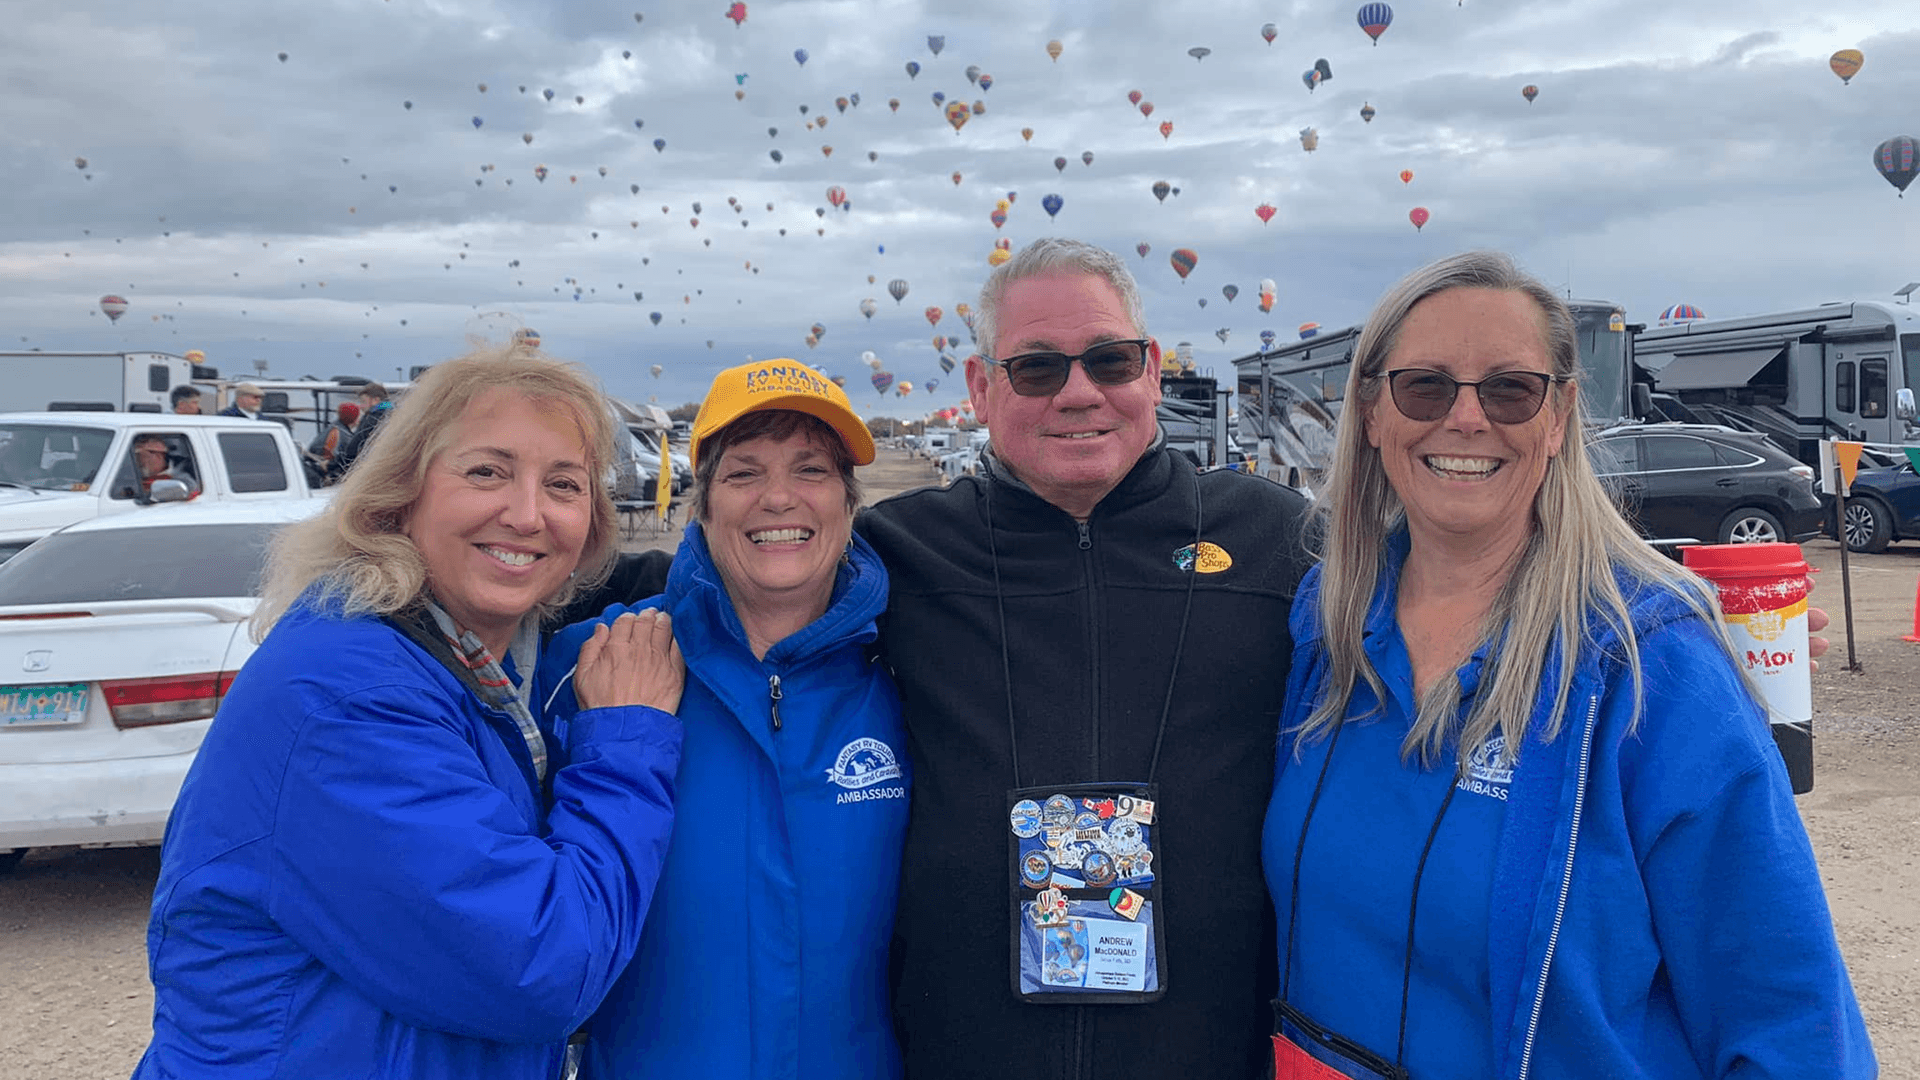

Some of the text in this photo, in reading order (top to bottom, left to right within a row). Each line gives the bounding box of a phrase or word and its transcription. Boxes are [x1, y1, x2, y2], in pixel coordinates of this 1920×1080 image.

[747, 366, 829, 395] FANTASY
[747, 378, 768, 389] RV
[1199, 543, 1221, 553] Bass
[1200, 549, 1217, 560] Pro
[1201, 558, 1230, 569] Shops
[837, 742, 861, 770] FANTASY
[836, 787, 905, 804] AMBASSADOR
[1118, 796, 1134, 817] 9
[1098, 936, 1134, 947] ANDREW
[1094, 946, 1138, 957] MacDONALD
